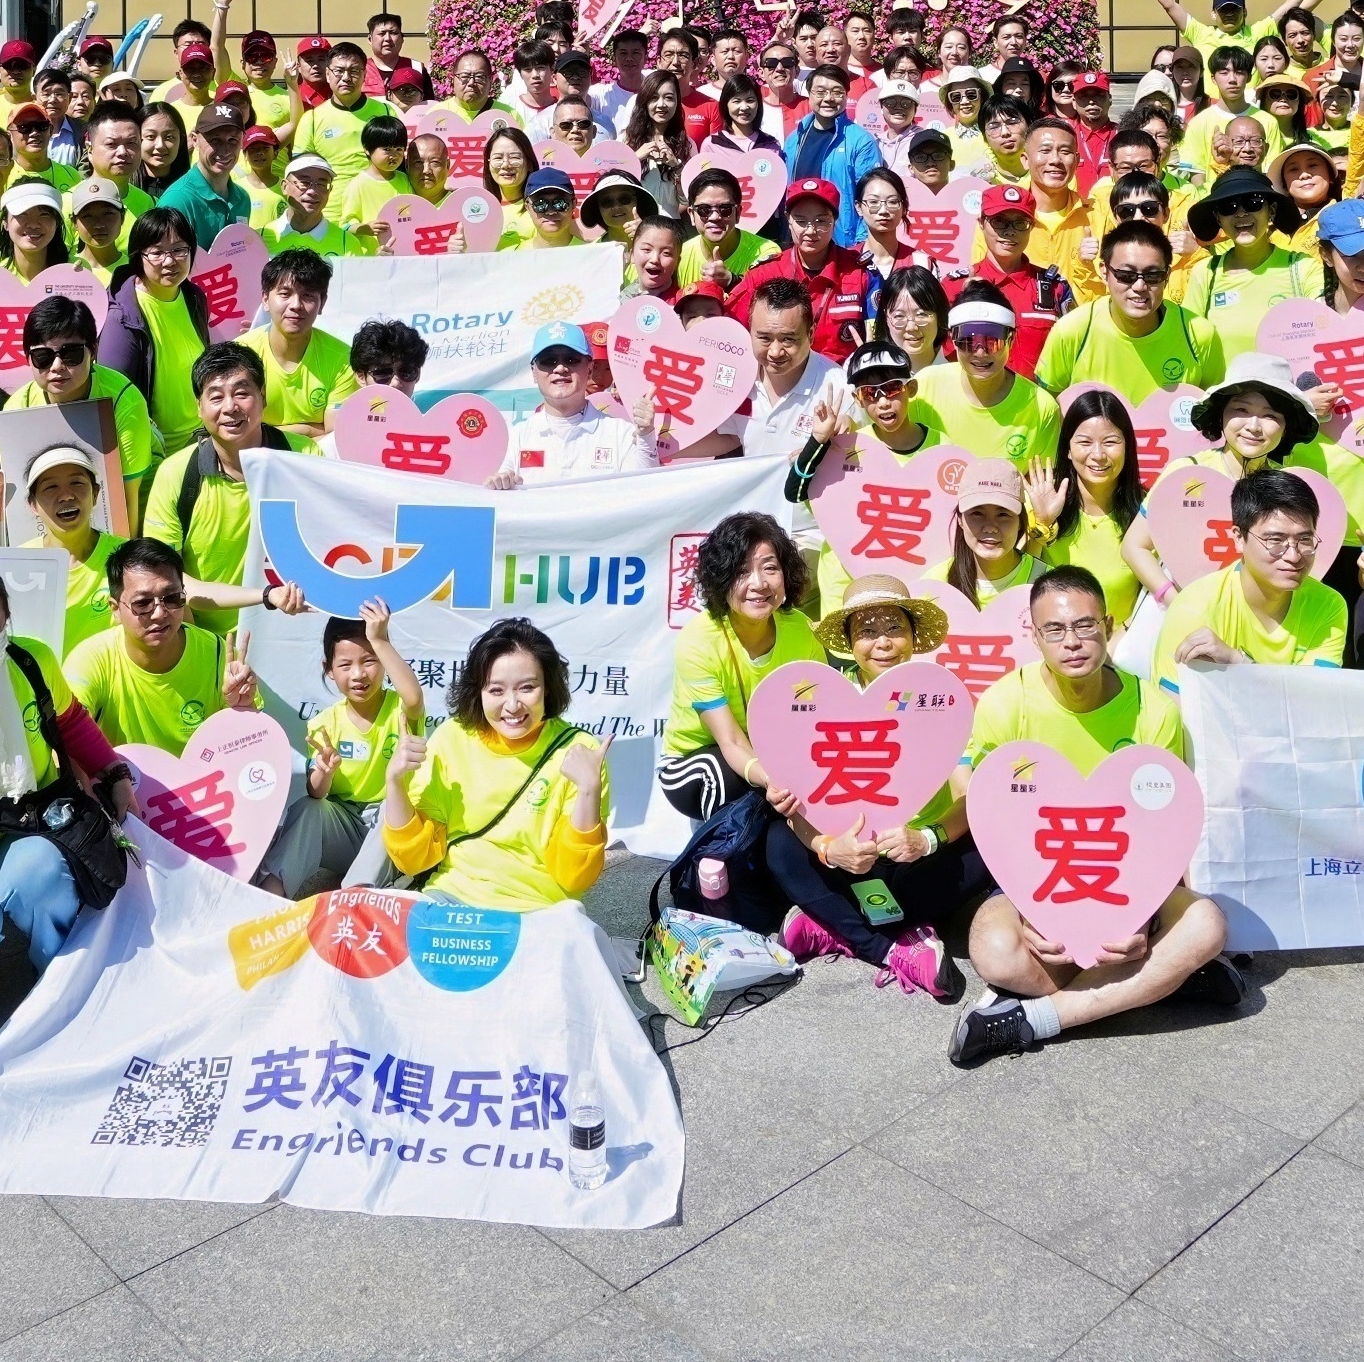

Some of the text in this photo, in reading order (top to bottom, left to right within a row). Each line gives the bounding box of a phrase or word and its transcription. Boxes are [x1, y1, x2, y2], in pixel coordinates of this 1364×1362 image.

[215, 105, 233, 119] NY
[447, 135, 487, 180] 爱
[908, 210, 960, 265] 爱
[192, 264, 246, 328] 爱
[411, 308, 514, 336] Rotary
[1292, 321, 1314, 329] Rotary
[642, 345, 706, 426] 爱
[1182, 500, 1206, 508] 星星彩
[851, 484, 932, 565] 爱
[503, 554, 646, 605] HUB
[571, 664, 629, 695] 力量
[791, 703, 817, 712] 星星彩
[915, 694, 945, 708] 星联
[610, 716, 645, 736] The
[807, 717, 902, 808] 爱
[1010, 783, 1038, 793] 星星彩
[147, 769, 245, 865] 爱
[1032, 805, 1131, 907] 爱
[249, 912, 310, 950] HARRIS
[446, 912, 484, 925] TEST
[331, 917, 387, 956] 英友
[432, 937, 492, 951] BUSINESS
[422, 952, 499, 967] FELLOWSHIP
[242, 1040, 568, 1132] 英友俱乐部
[461, 1141, 564, 1171] Club
